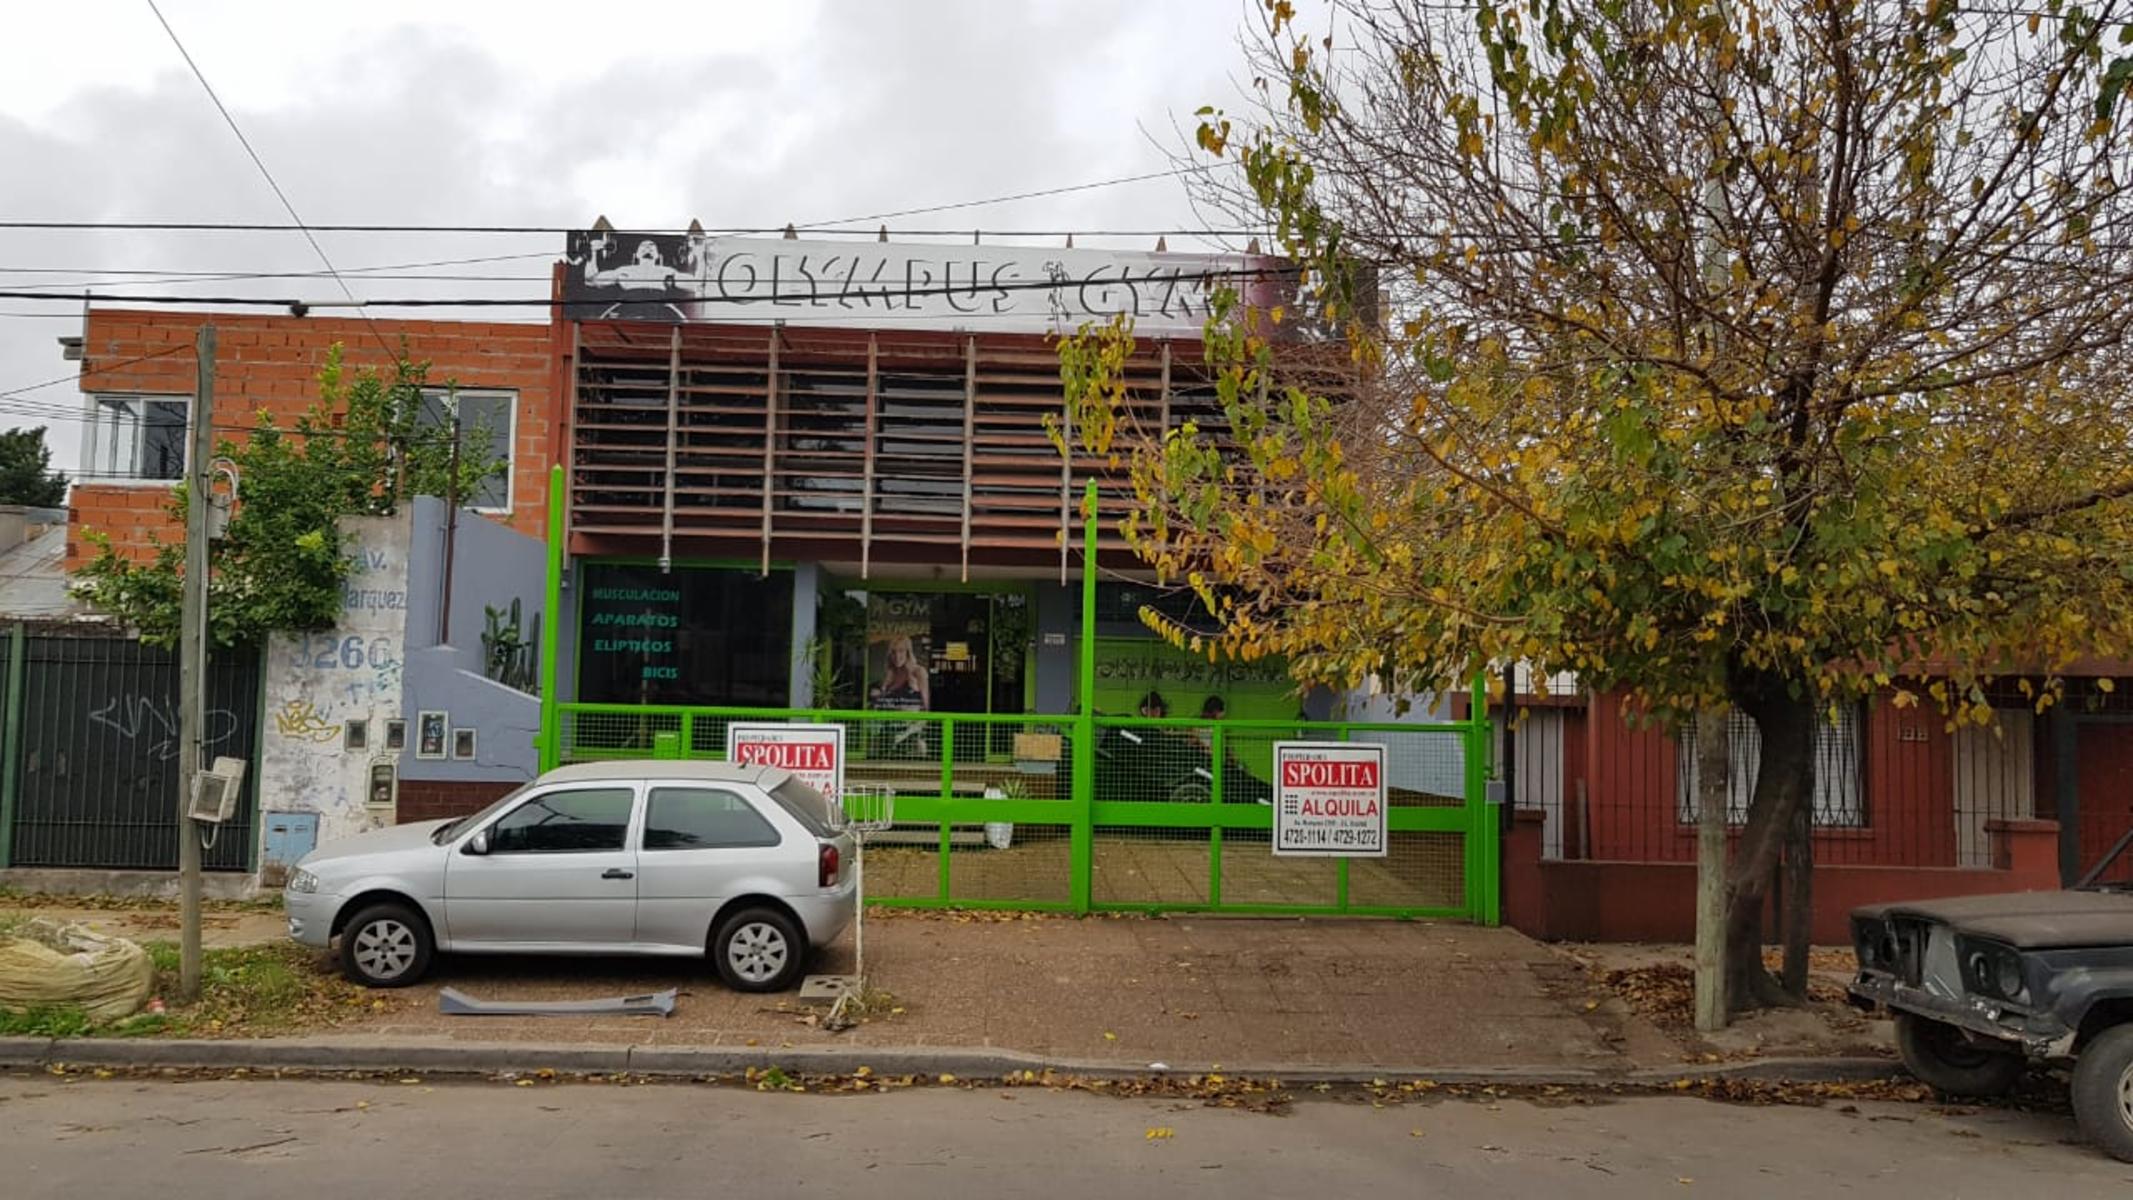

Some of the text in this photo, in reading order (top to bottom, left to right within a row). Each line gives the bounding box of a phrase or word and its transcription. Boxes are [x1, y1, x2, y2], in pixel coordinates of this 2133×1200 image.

[718, 252, 1019, 312] OLYMPUS
[592, 613, 679, 627] APARATOS
[594, 639, 673, 653] ELIPTICOS
[642, 666, 679, 679] BICIS
[742, 744, 830, 767] SPOLITA
[1287, 762, 1374, 786] SPOLITA
[1301, 798, 1379, 816] ALQUILA
